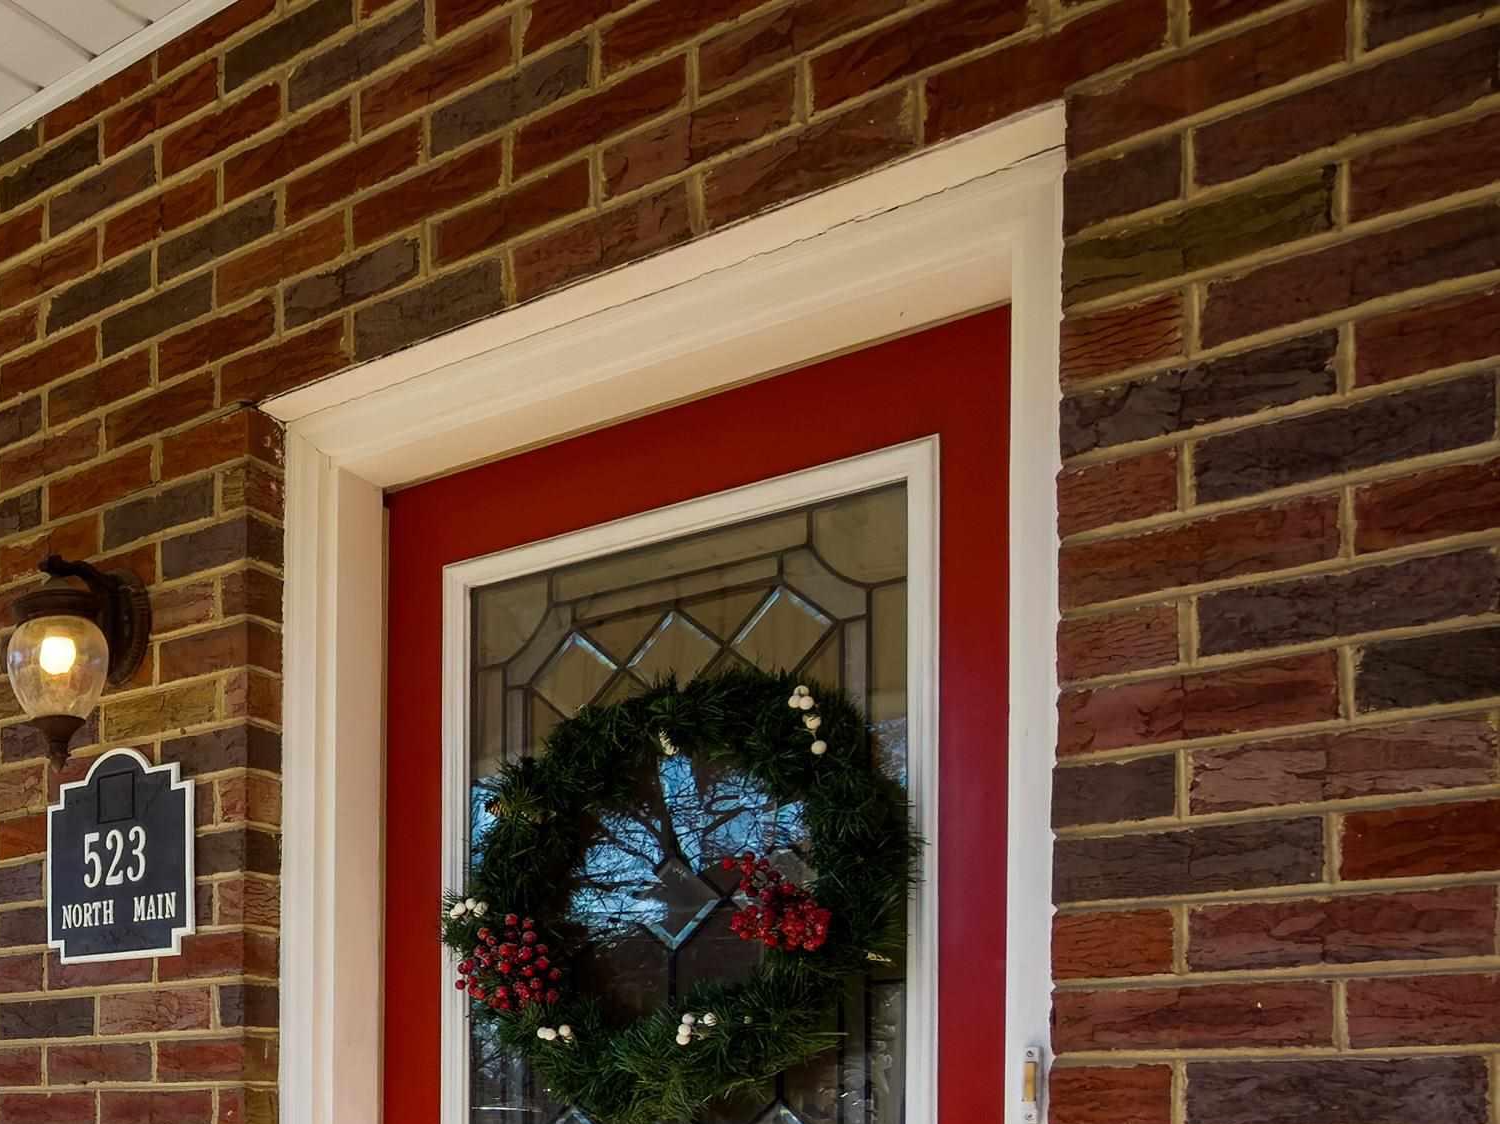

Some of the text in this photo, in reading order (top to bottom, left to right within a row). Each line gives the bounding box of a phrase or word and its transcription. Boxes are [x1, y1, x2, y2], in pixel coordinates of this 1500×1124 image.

[84, 825, 147, 888] 523
[61, 891, 177, 930] NORTH MAIN
